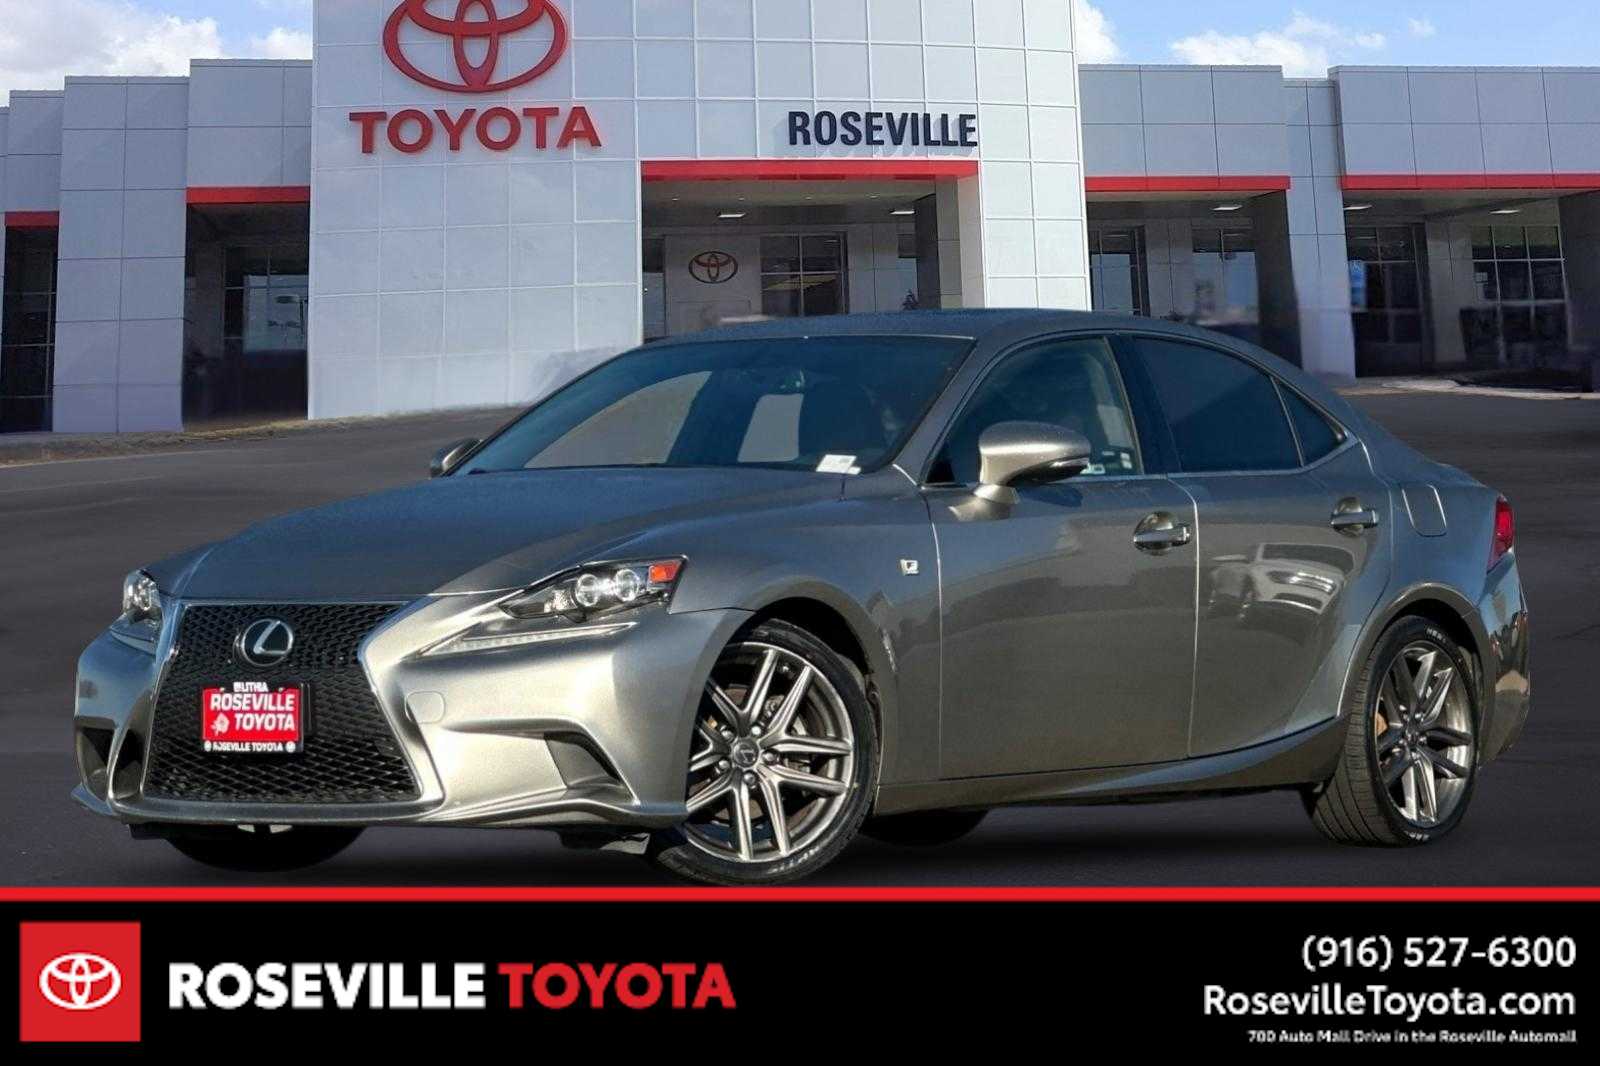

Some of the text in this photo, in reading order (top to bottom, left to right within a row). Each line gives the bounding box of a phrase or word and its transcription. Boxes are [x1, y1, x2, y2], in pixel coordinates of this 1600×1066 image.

[349, 105, 602, 154] TOYOTA
[789, 110, 978, 148] ROSEVILLE
[210, 693, 295, 711] ROSEVILLE
[234, 713, 295, 731] TOYOTA
[252, 742, 283, 752] TOYOTA
